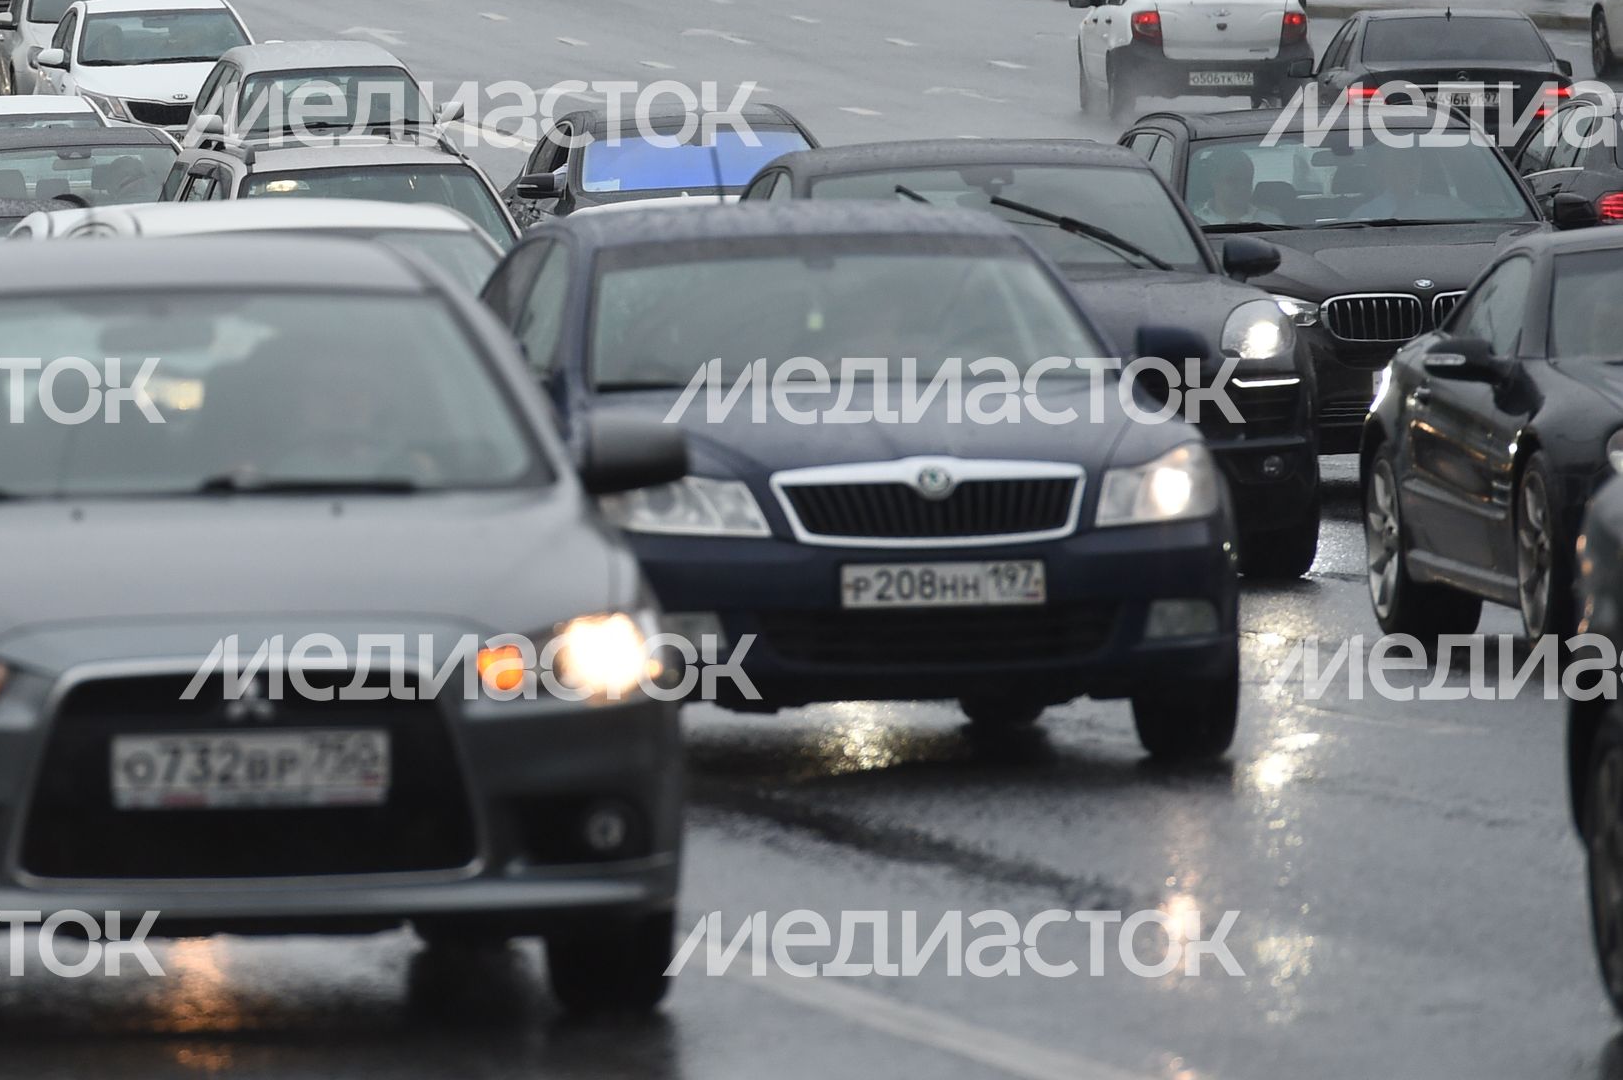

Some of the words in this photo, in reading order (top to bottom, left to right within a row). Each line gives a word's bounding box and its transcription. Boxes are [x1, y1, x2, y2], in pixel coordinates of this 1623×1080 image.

[852, 567, 981, 602] Р208НН
[987, 562, 1035, 590] 197
[122, 737, 299, 787] О732ВР
